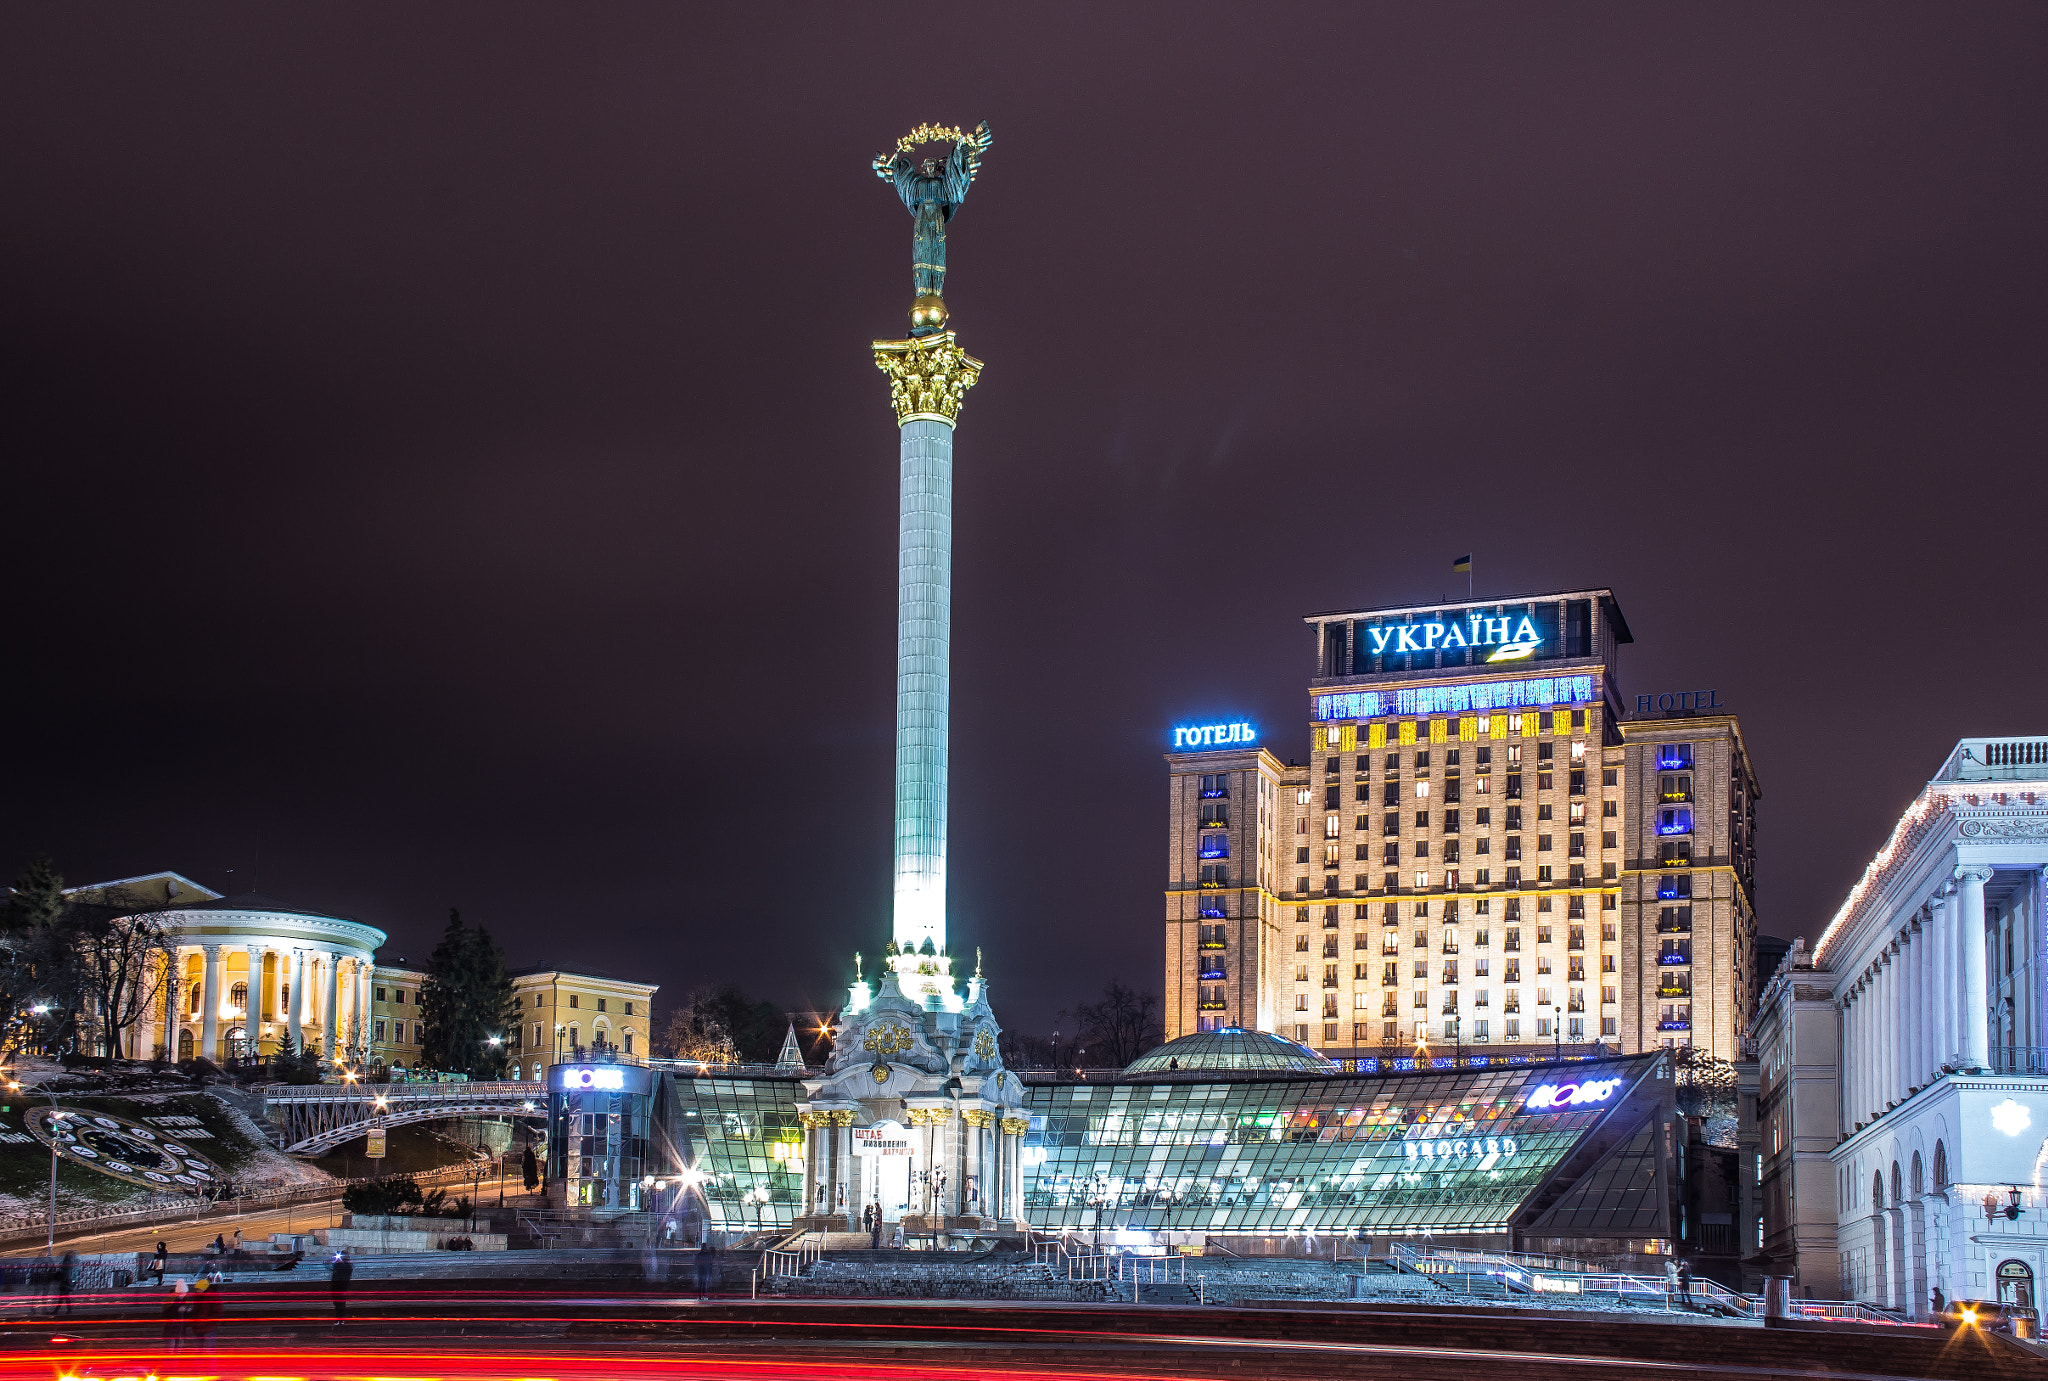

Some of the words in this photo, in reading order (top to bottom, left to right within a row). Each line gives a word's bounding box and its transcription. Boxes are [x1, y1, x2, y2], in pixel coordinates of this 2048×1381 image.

[1368, 614, 1540, 654] УКРАЇНА
[1635, 689, 1724, 712] HOTEL
[1174, 723, 1255, 746] ГОТЕЛЬ
[855, 1129, 883, 1139] ШТАБ
[1405, 1138, 1516, 1161] BROCARD
